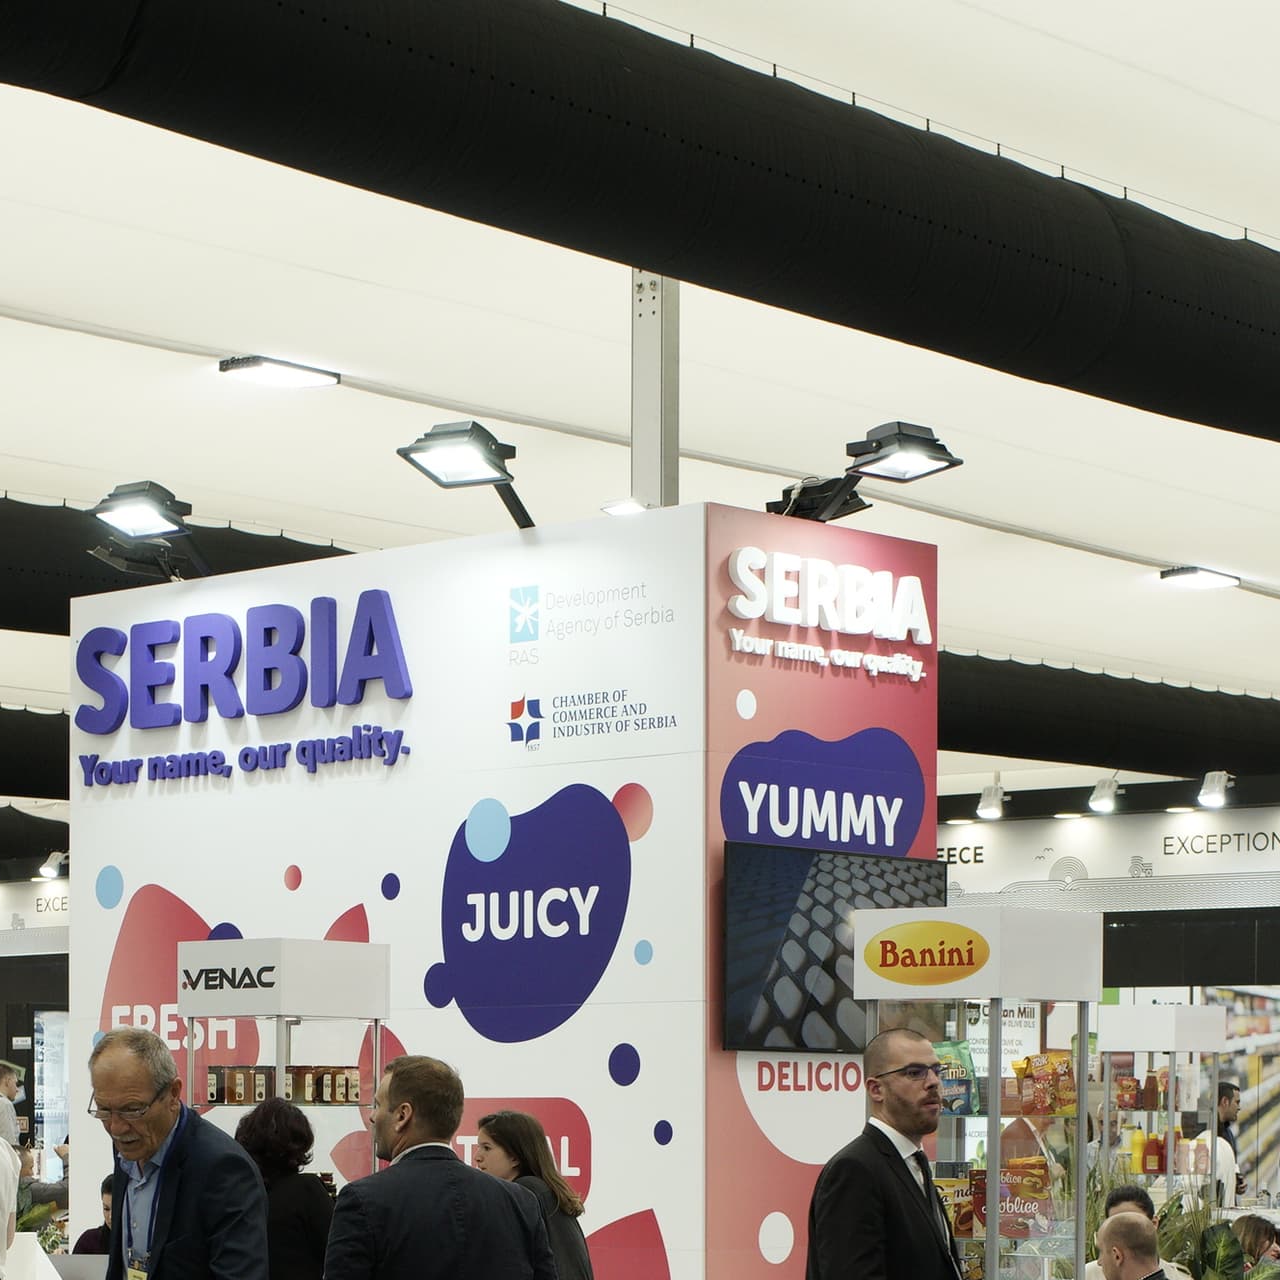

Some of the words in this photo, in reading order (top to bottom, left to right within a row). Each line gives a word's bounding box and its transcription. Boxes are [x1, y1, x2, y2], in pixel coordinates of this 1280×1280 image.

[546, 582, 646, 609] Development
[727, 546, 933, 644] SERBIA
[546, 616, 600, 640] Agency
[605, 615, 621, 630] of
[624, 605, 675, 628] Serbia
[729, 627, 773, 655] Your
[75, 589, 412, 735] SERBIA
[552, 691, 610, 708] CHAMBER
[612, 689, 628, 703] OF
[552, 705, 618, 723] COMMERCE
[621, 702, 647, 716] AND
[552, 721, 613, 738] INDUSTRY
[615, 720, 631, 732] OF
[634, 715, 678, 731] SERBIA
[79, 754, 142, 786] Your
[148, 750, 232, 780] name,
[238, 742, 291, 772] our
[295, 725, 411, 773] quality.
[738, 781, 903, 847] YUMMY
[461, 885, 600, 942] JUICY
[878, 939, 975, 969] Banini
[183, 966, 276, 990] VENAC
[757, 1061, 862, 1092] DELICIO
